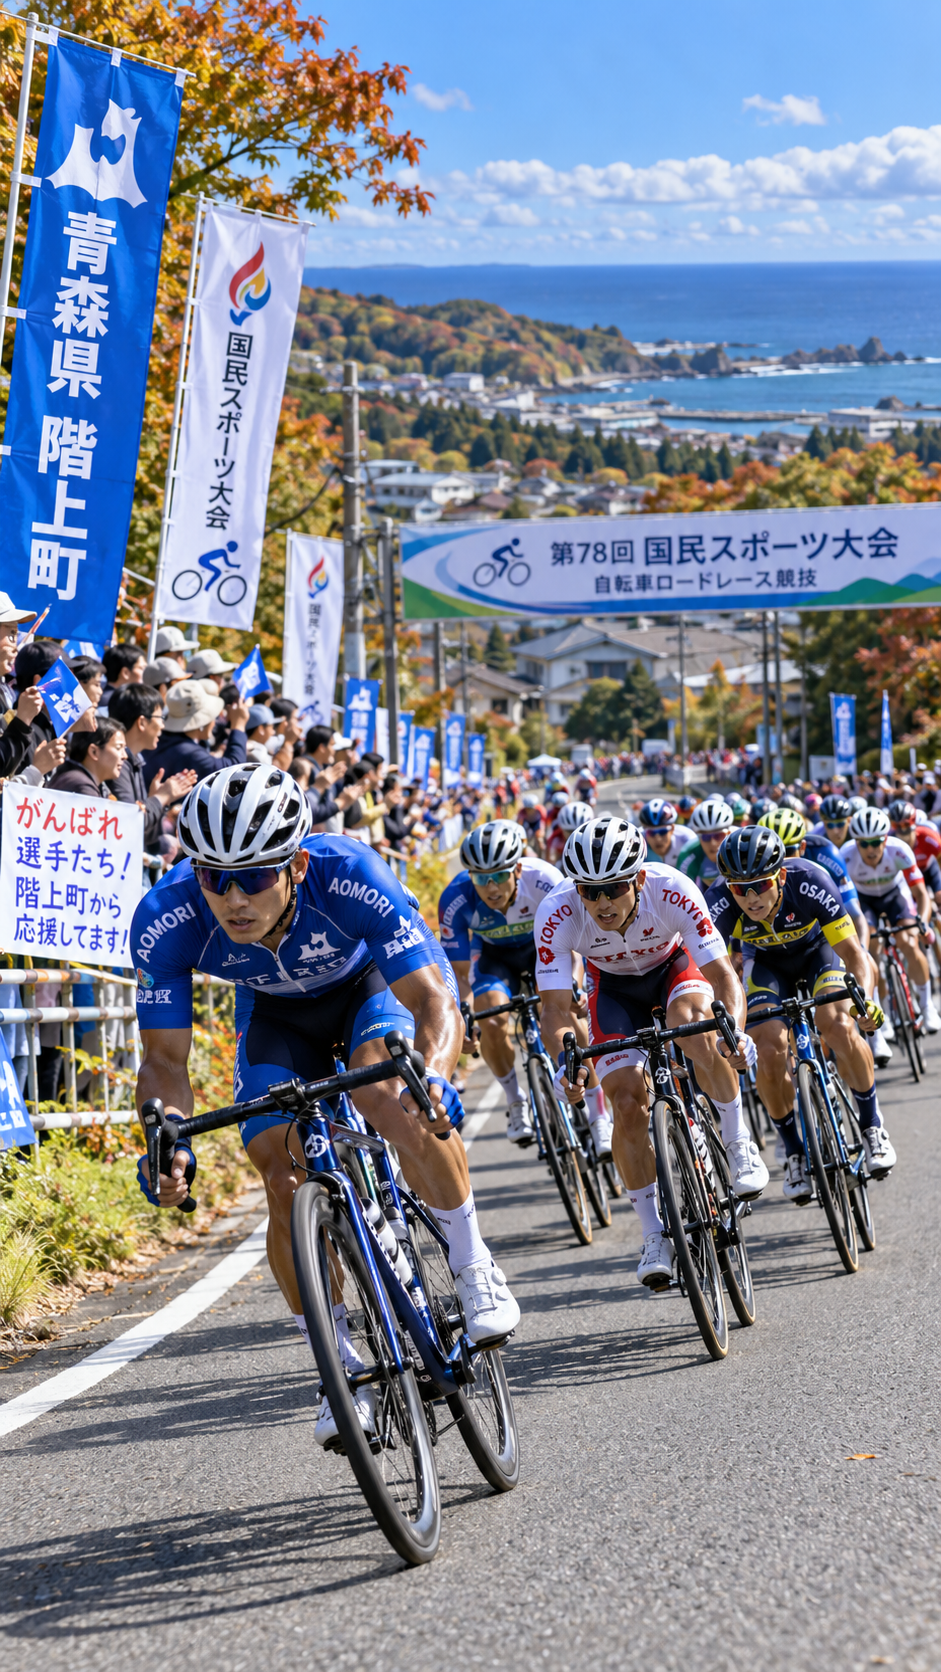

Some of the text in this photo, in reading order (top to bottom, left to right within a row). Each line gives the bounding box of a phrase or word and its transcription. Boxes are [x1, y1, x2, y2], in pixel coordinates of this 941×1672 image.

[27, 211, 118, 601] 青森県 階上町
[205, 331, 254, 531] 国民スポーツ大会
[550, 526, 899, 567] 第78回 国民スポーツ大会
[594, 568, 818, 595] 自転車ロードレース競技
[16, 796, 123, 840] がんばれ
[16, 836, 132, 881] 選手たち！
[15, 876, 122, 919] 階上町から
[328, 877, 395, 918] AOMORI
[799, 881, 841, 917] OSAKA
[13, 913, 128, 955] 応援してます！
[136, 902, 197, 963] AOMORI
